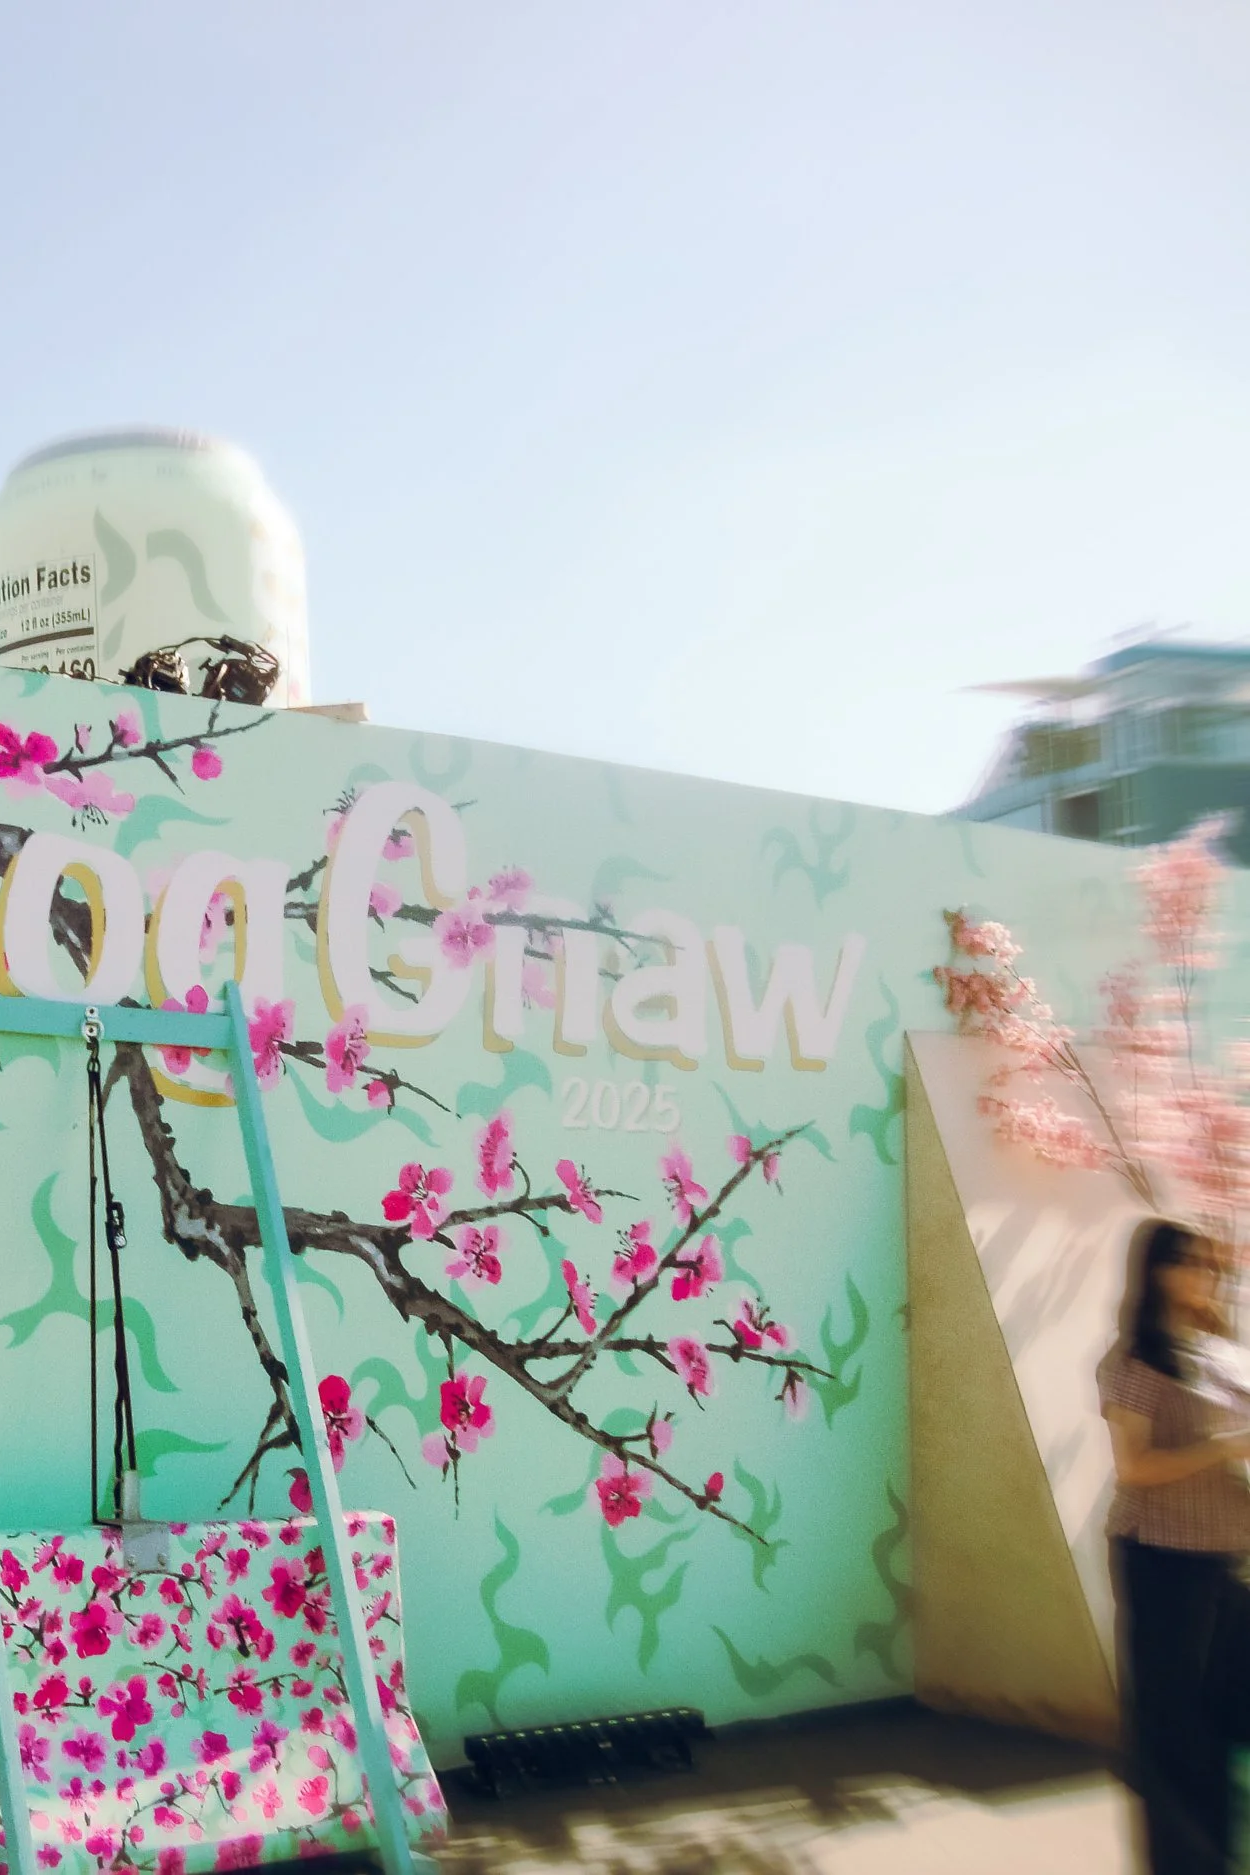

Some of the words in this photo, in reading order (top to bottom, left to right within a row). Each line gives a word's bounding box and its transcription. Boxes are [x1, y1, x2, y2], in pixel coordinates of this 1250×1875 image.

[36, 561, 92, 592] Facts
[21, 619, 30, 633] 12
[40, 617, 50, 629] oz
[52, 607, 91, 629] (355mL)
[561, 1076, 682, 1134] 2025
